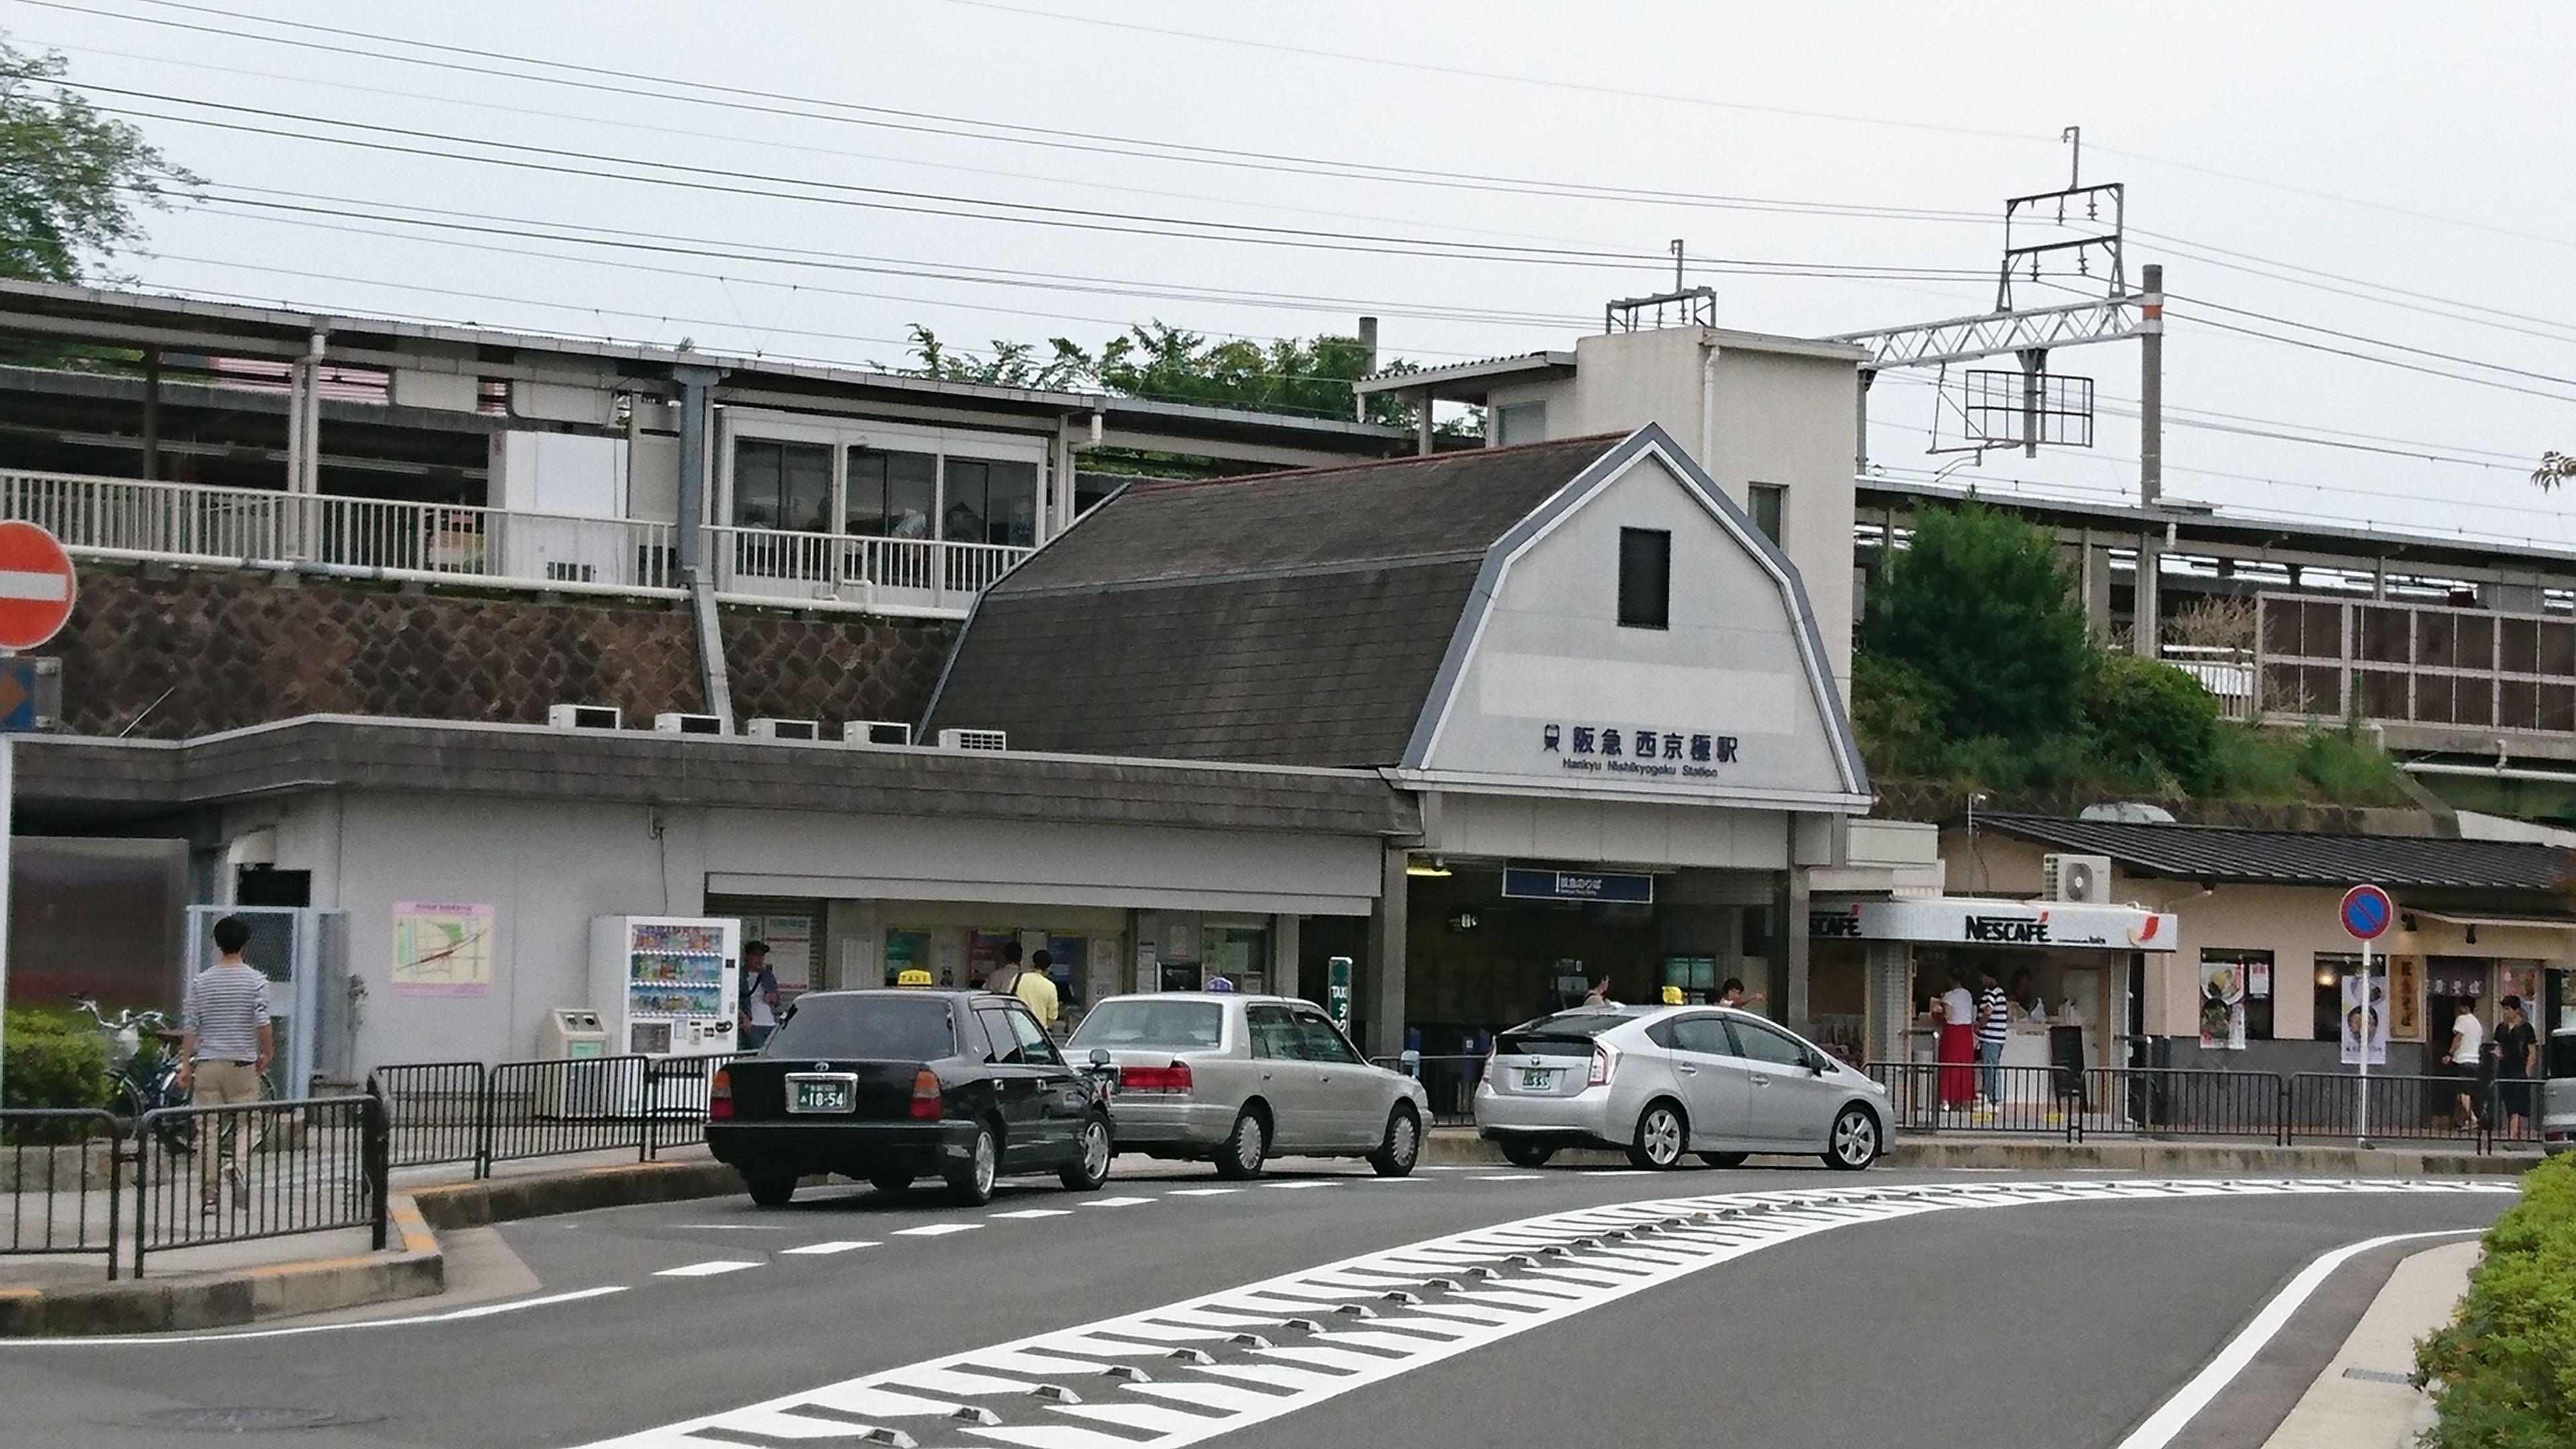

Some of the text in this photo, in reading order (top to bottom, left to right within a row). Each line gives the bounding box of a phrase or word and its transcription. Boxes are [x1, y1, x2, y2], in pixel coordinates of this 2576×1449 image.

[1572, 726, 1622, 755] 阪急
[1562, 757, 1718, 777] Hankyu Nishikyogoku Station
[809, 1091, 844, 1107] 18-54
